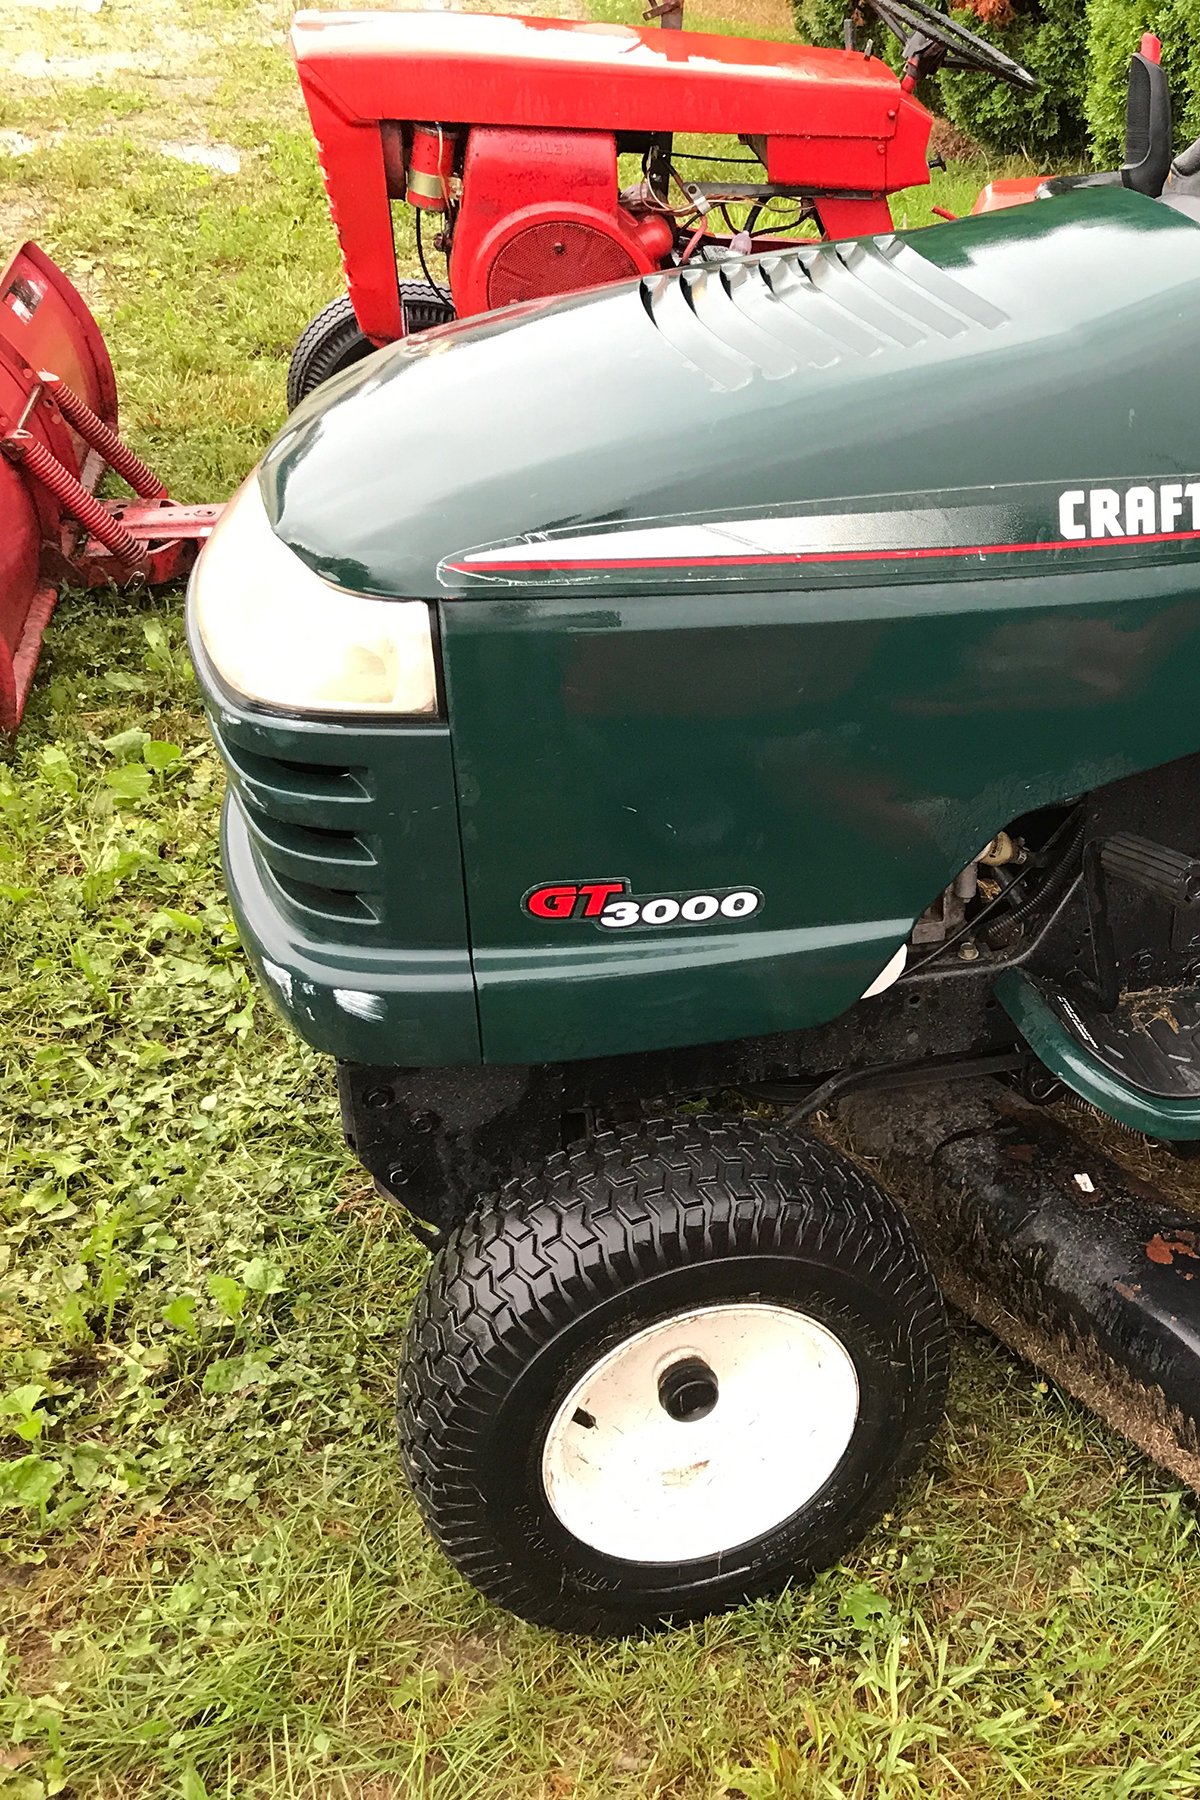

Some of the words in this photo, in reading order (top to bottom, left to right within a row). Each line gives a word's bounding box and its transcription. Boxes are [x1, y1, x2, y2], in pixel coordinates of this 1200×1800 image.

[509, 139, 575, 156] KOHLER
[528, 883, 624, 918] GT
[600, 891, 758, 928] 3000
